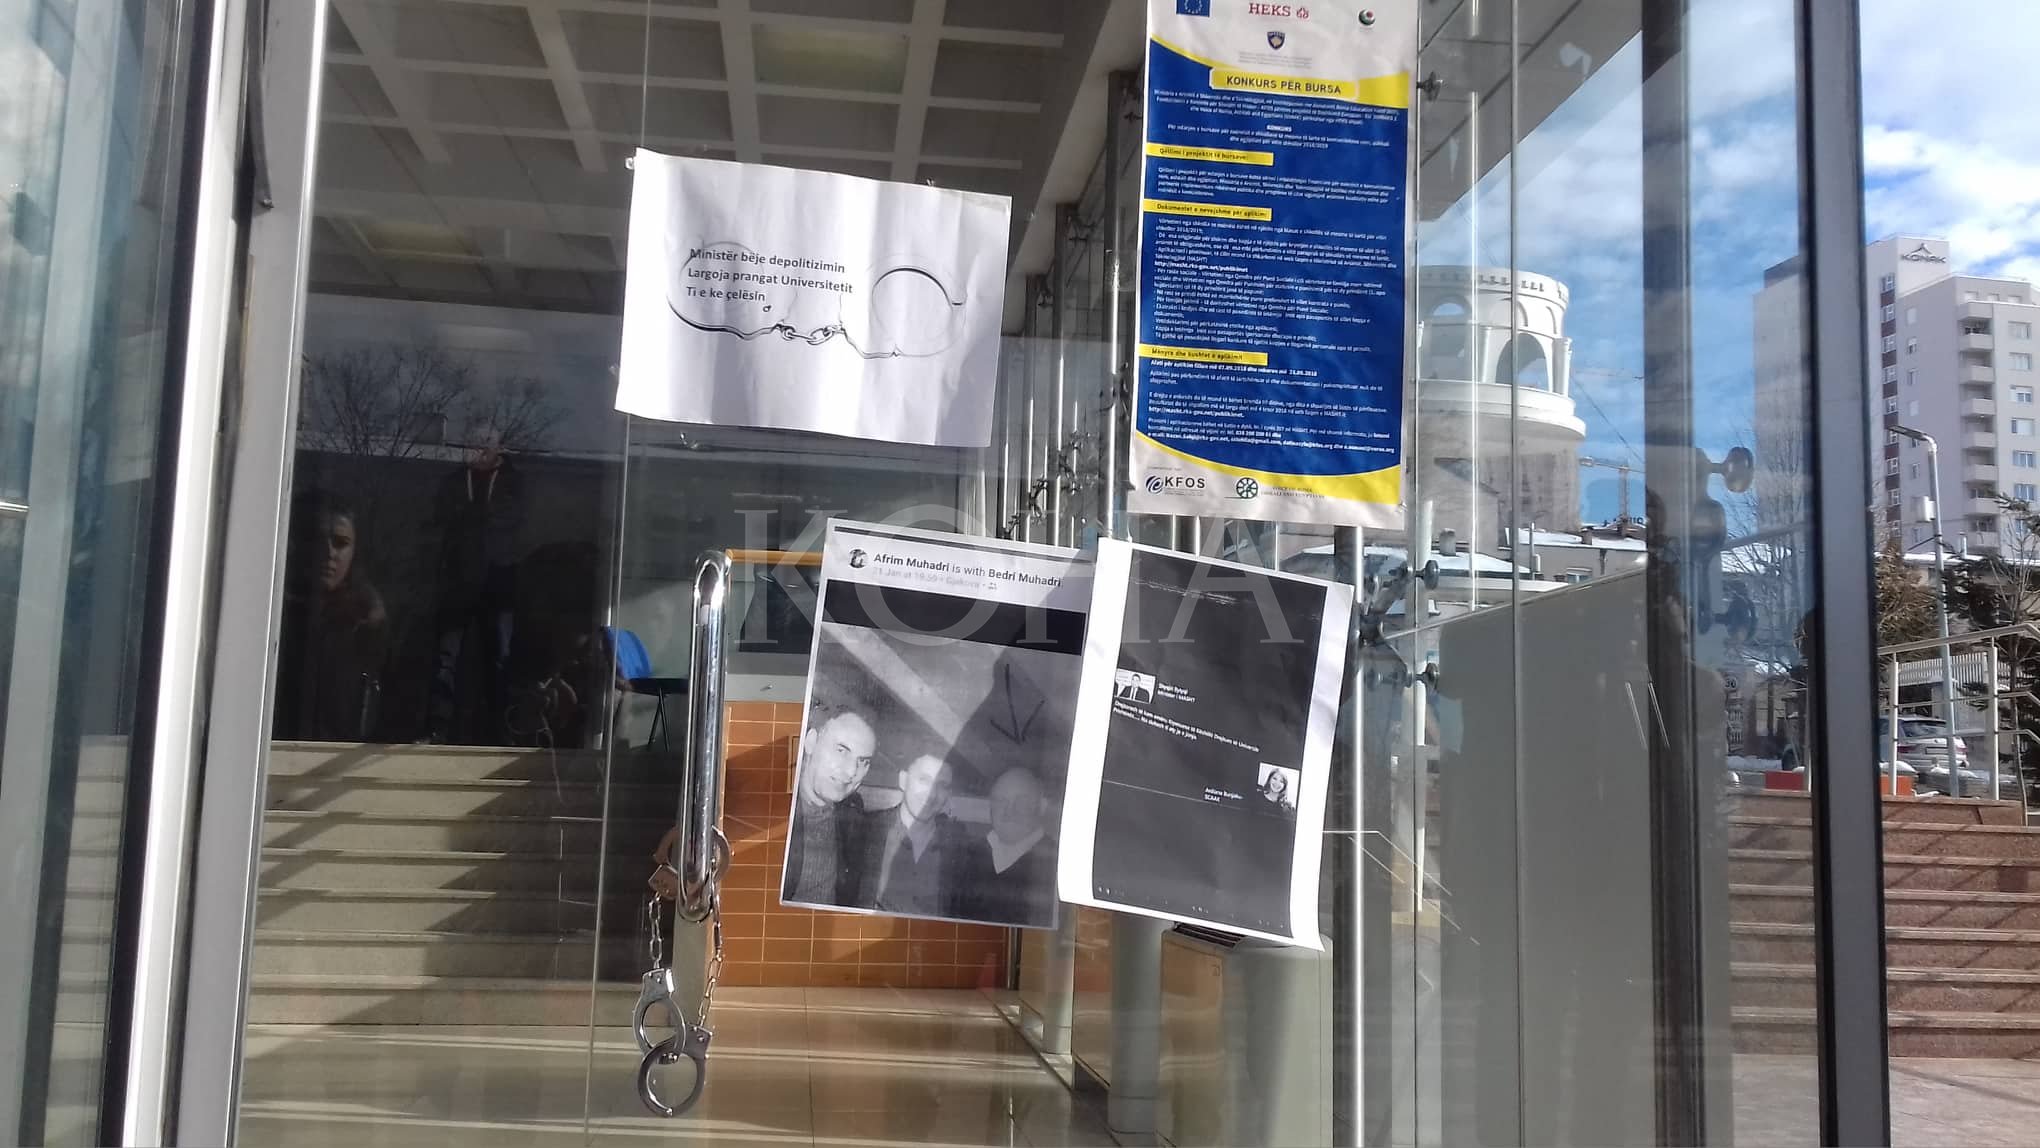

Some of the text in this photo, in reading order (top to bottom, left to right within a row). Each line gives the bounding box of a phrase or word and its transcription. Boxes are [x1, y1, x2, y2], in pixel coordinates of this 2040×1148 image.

[1249, 3, 1291, 17] HEKS
[1226, 75, 1277, 89] KONKURS
[1305, 82, 1341, 94] BURSA
[690, 248, 845, 273] Ministër bëje depolitizimin
[1901, 254, 1946, 263] KONAK
[688, 268, 853, 293] Largoja prangat Universitetit
[686, 286, 766, 301] Ti e ke çelësin
[1165, 476, 1205, 489] KFOS
[873, 553, 903, 566] Afrim
[906, 557, 950, 572] Muhadri
[952, 563, 961, 573] is
[964, 564, 986, 577] with
[988, 568, 1016, 581] Bedri
